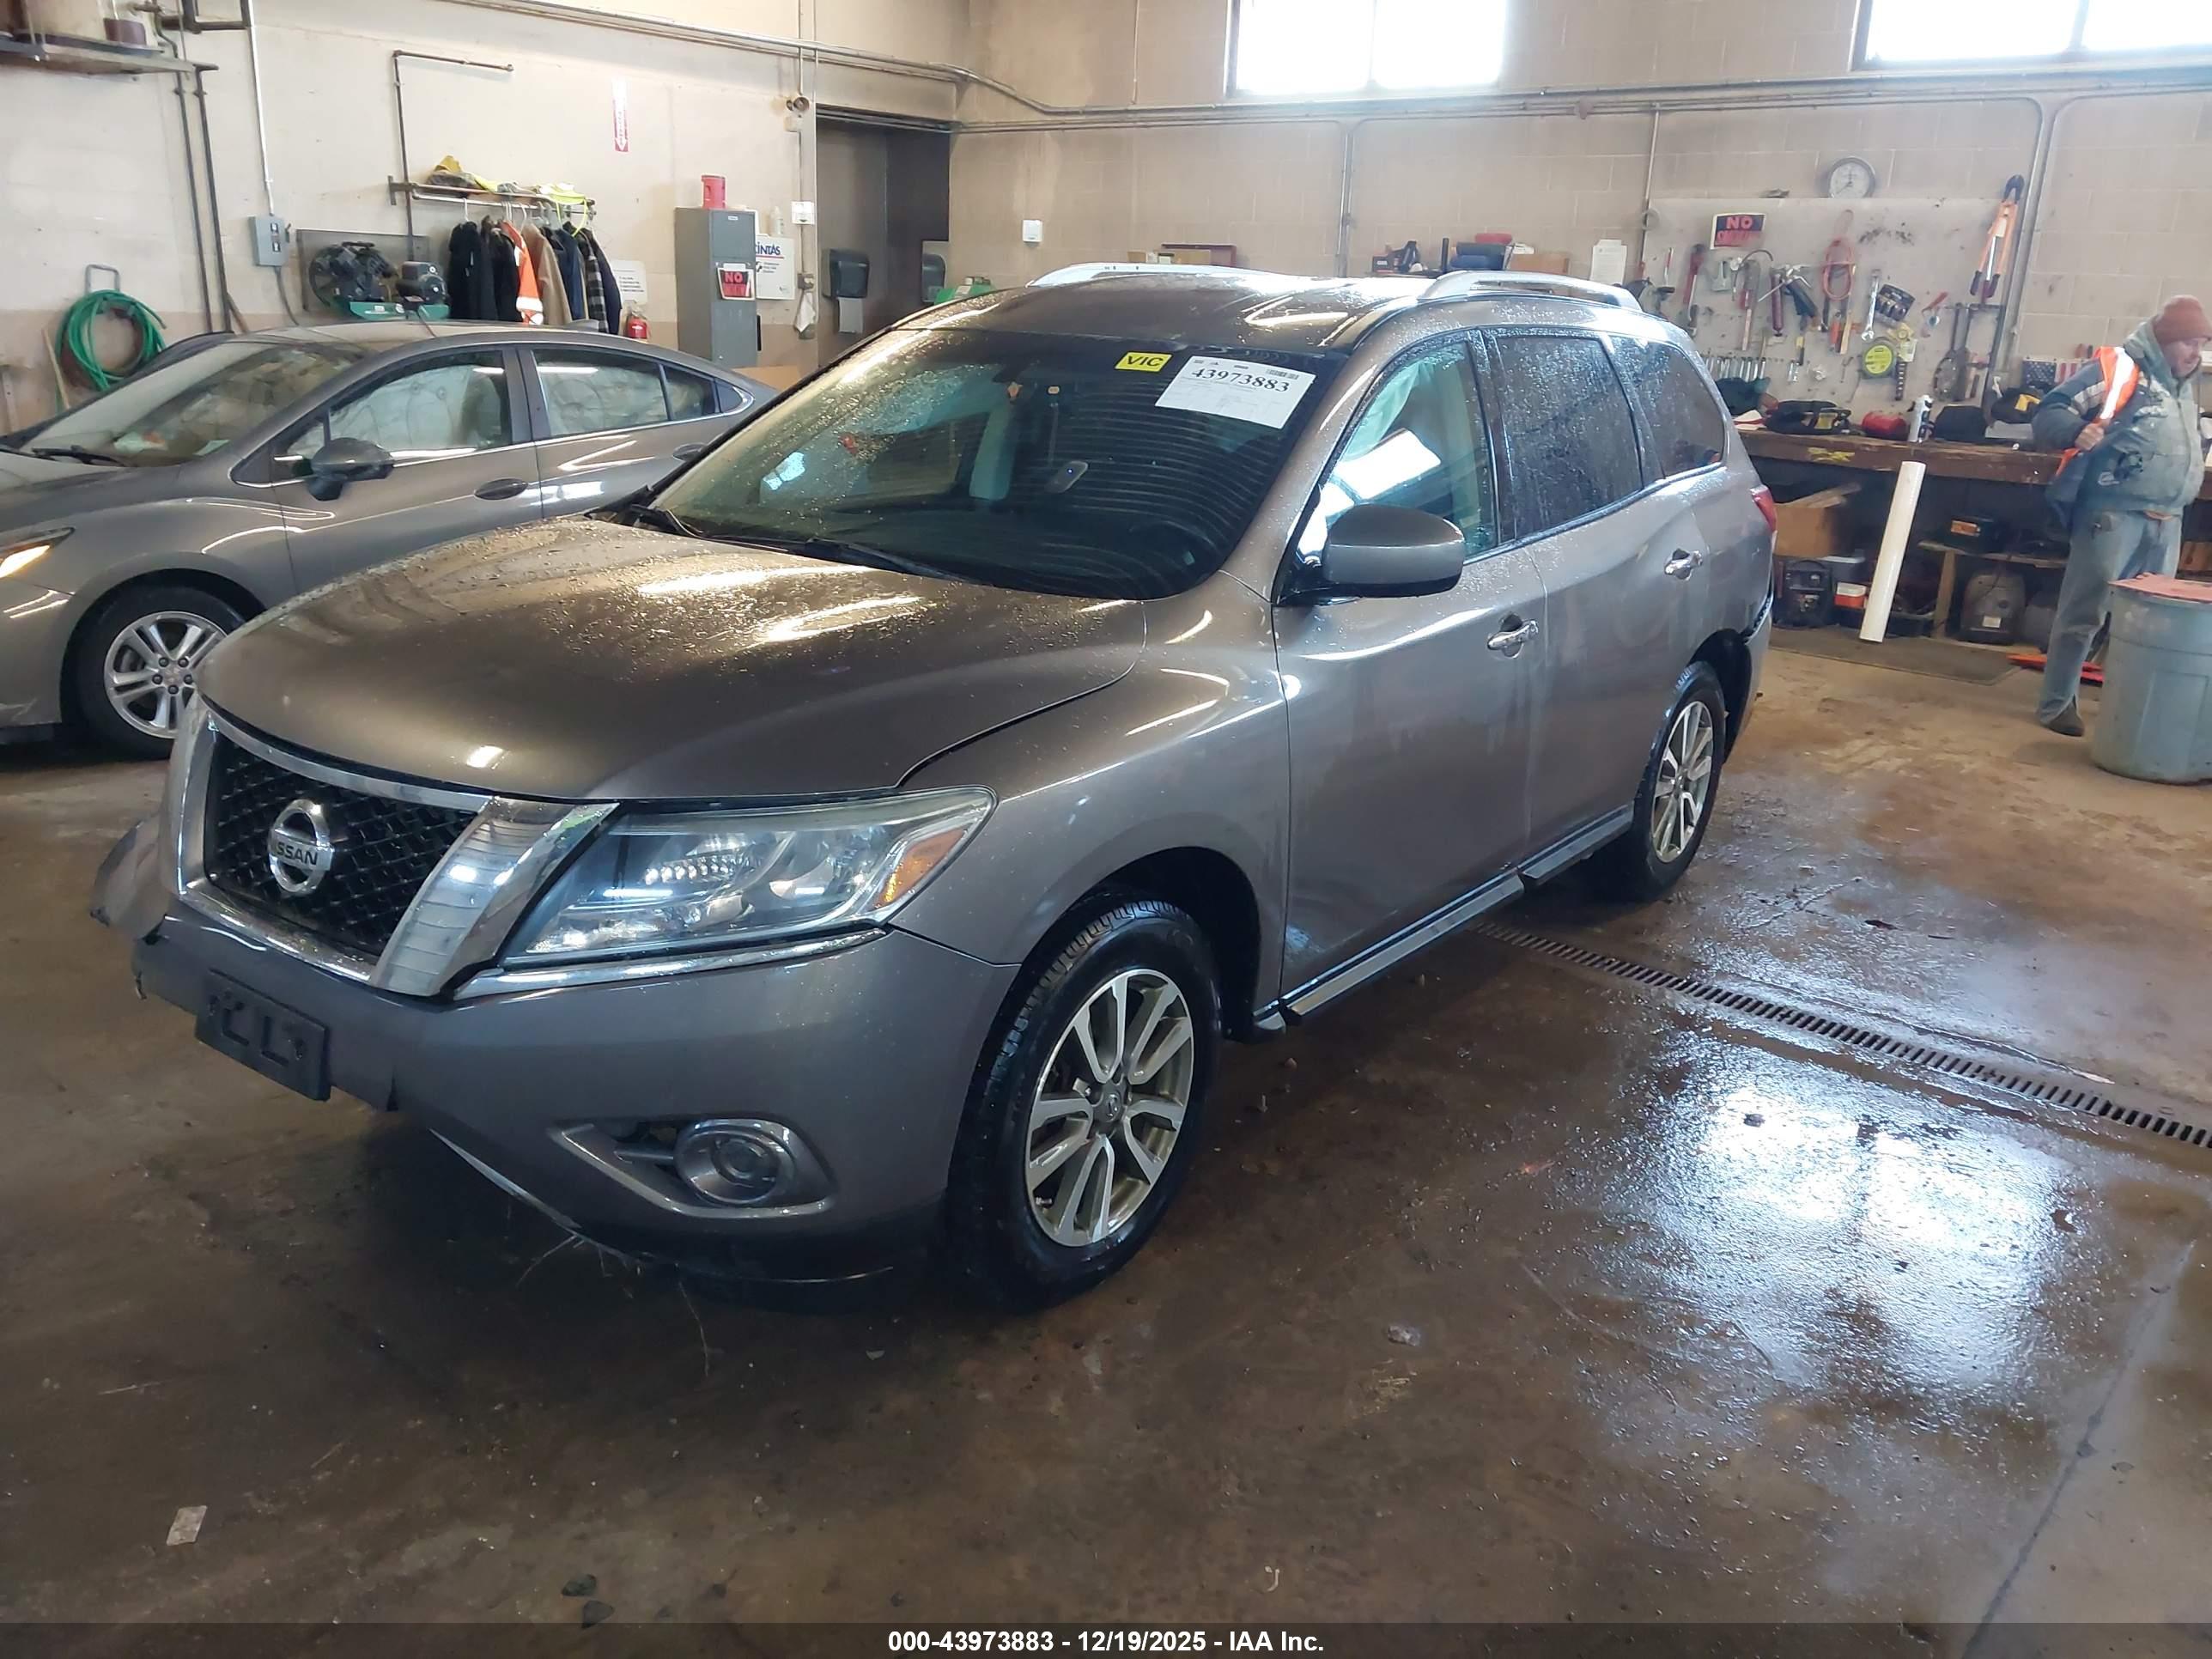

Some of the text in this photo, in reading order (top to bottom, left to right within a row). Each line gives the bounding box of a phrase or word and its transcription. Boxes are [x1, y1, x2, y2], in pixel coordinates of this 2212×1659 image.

[1726, 216, 1753, 230] NO
[725, 272, 744, 283] NO
[1127, 356, 1164, 367] VIC
[1191, 368, 1290, 392] 43973883
